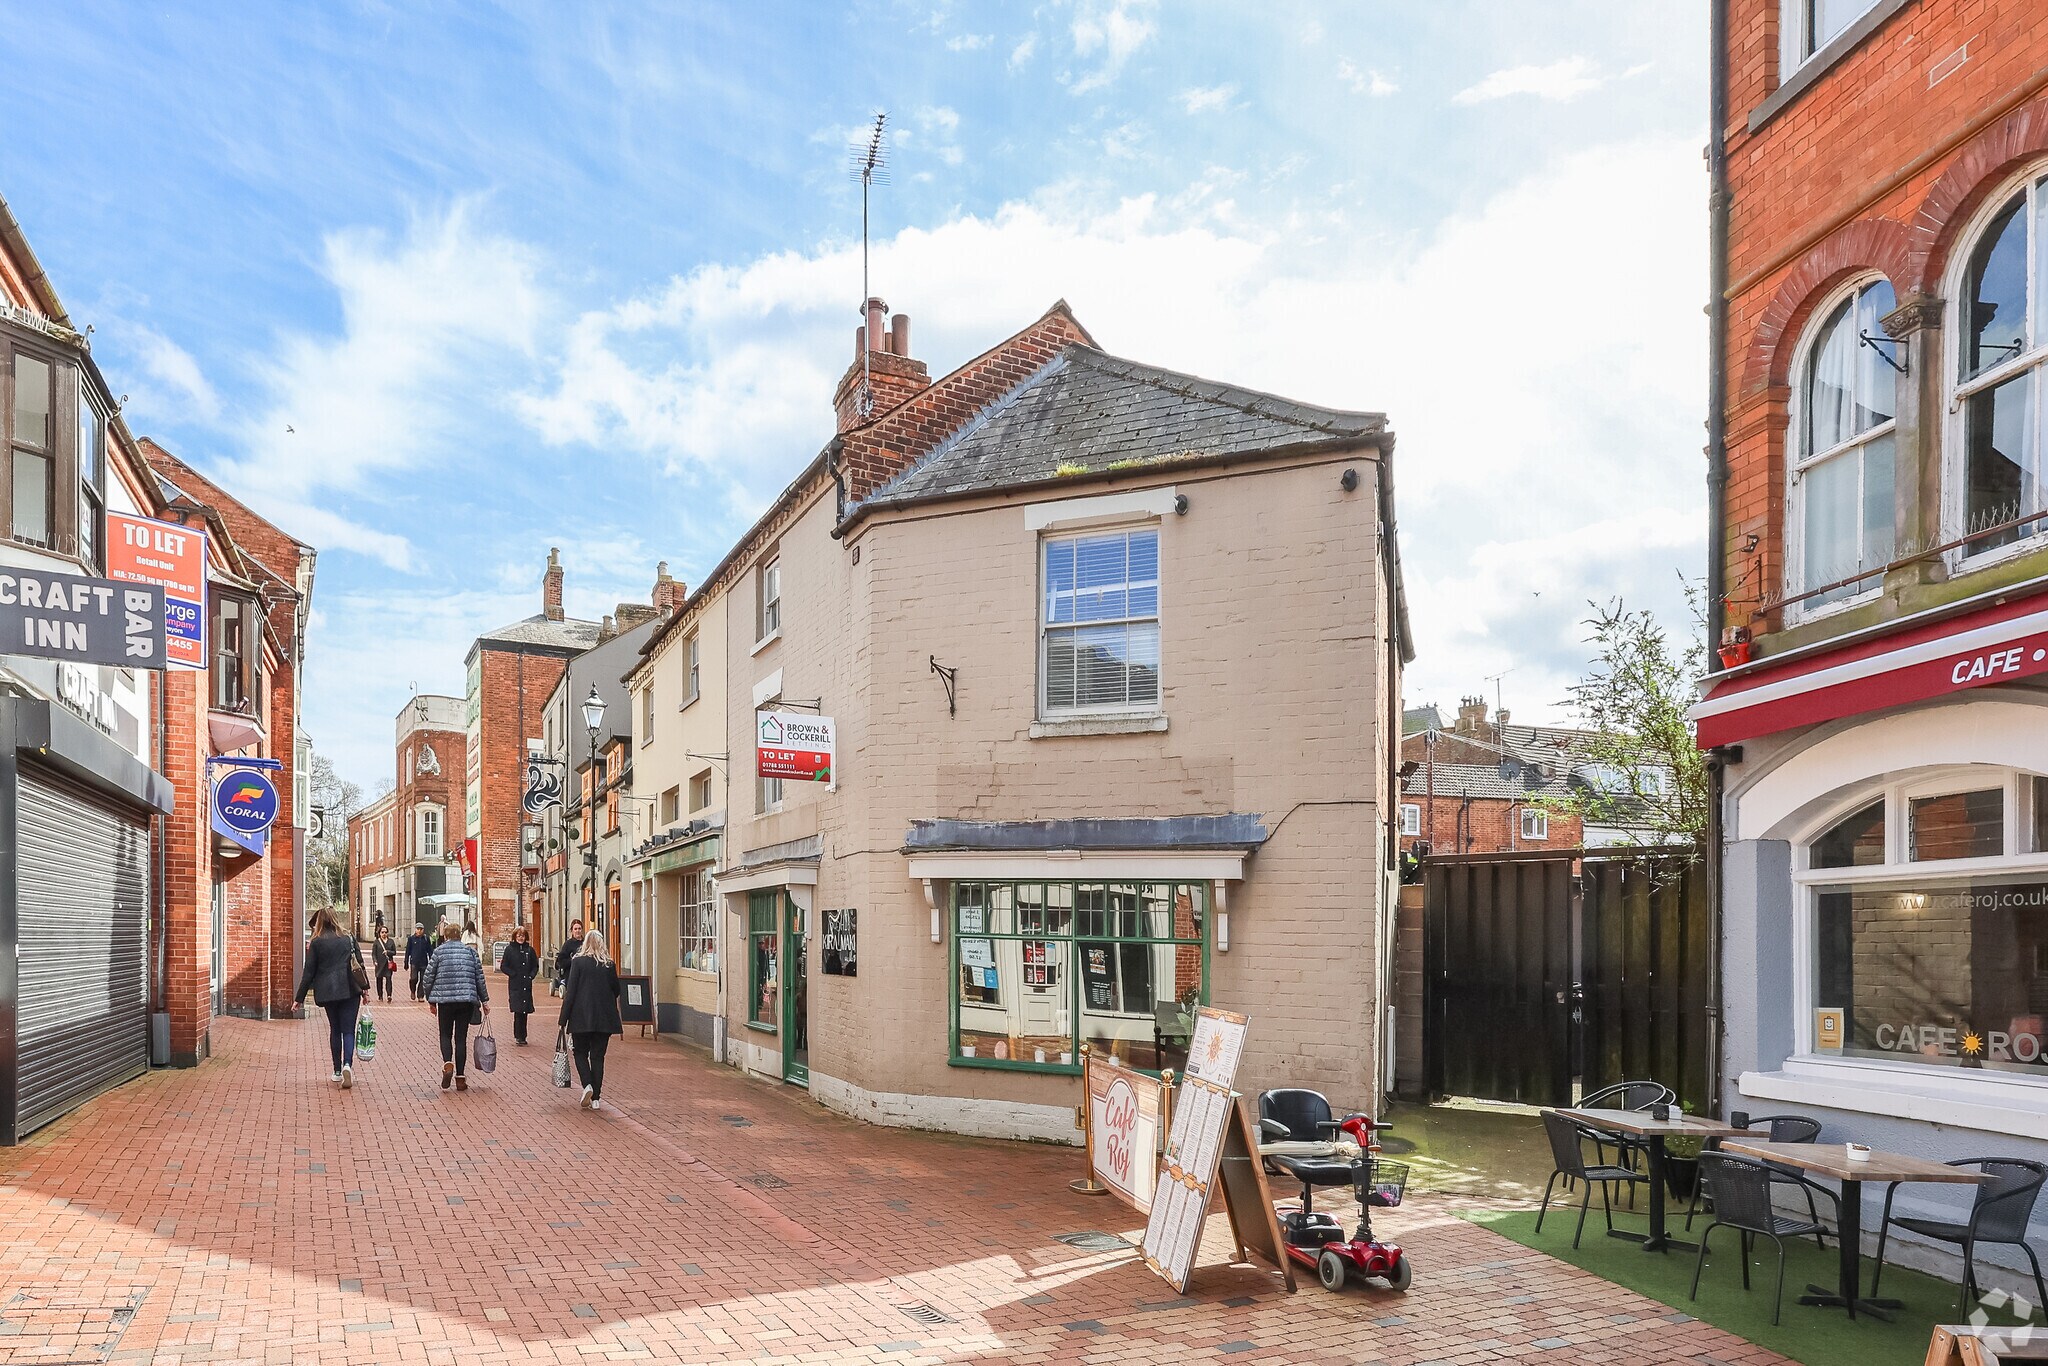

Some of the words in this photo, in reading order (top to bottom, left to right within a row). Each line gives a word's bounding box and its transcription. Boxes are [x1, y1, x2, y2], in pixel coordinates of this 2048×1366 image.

[122, 522, 150, 548] TO
[154, 529, 186, 557] LET
[136, 555, 159, 568] Retail
[159, 560, 175, 572] Unit
[0, 574, 114, 616] CRAFT
[24, 616, 88, 652] INN
[124, 589, 154, 659] BAR
[1951, 646, 2024, 684] CAFE
[786, 723, 820, 734] BROWN
[821, 725, 829, 735] &
[786, 731, 831, 744] COCKERILL
[786, 740, 832, 749] LETTINGS
[762, 751, 775, 759] TO
[778, 752, 795, 761] LET
[224, 805, 267, 821] CORAL
[1875, 1023, 1957, 1055] CAFE
[1105, 1095, 1136, 1141] Cafe
[1107, 1133, 1131, 1182] Roj
